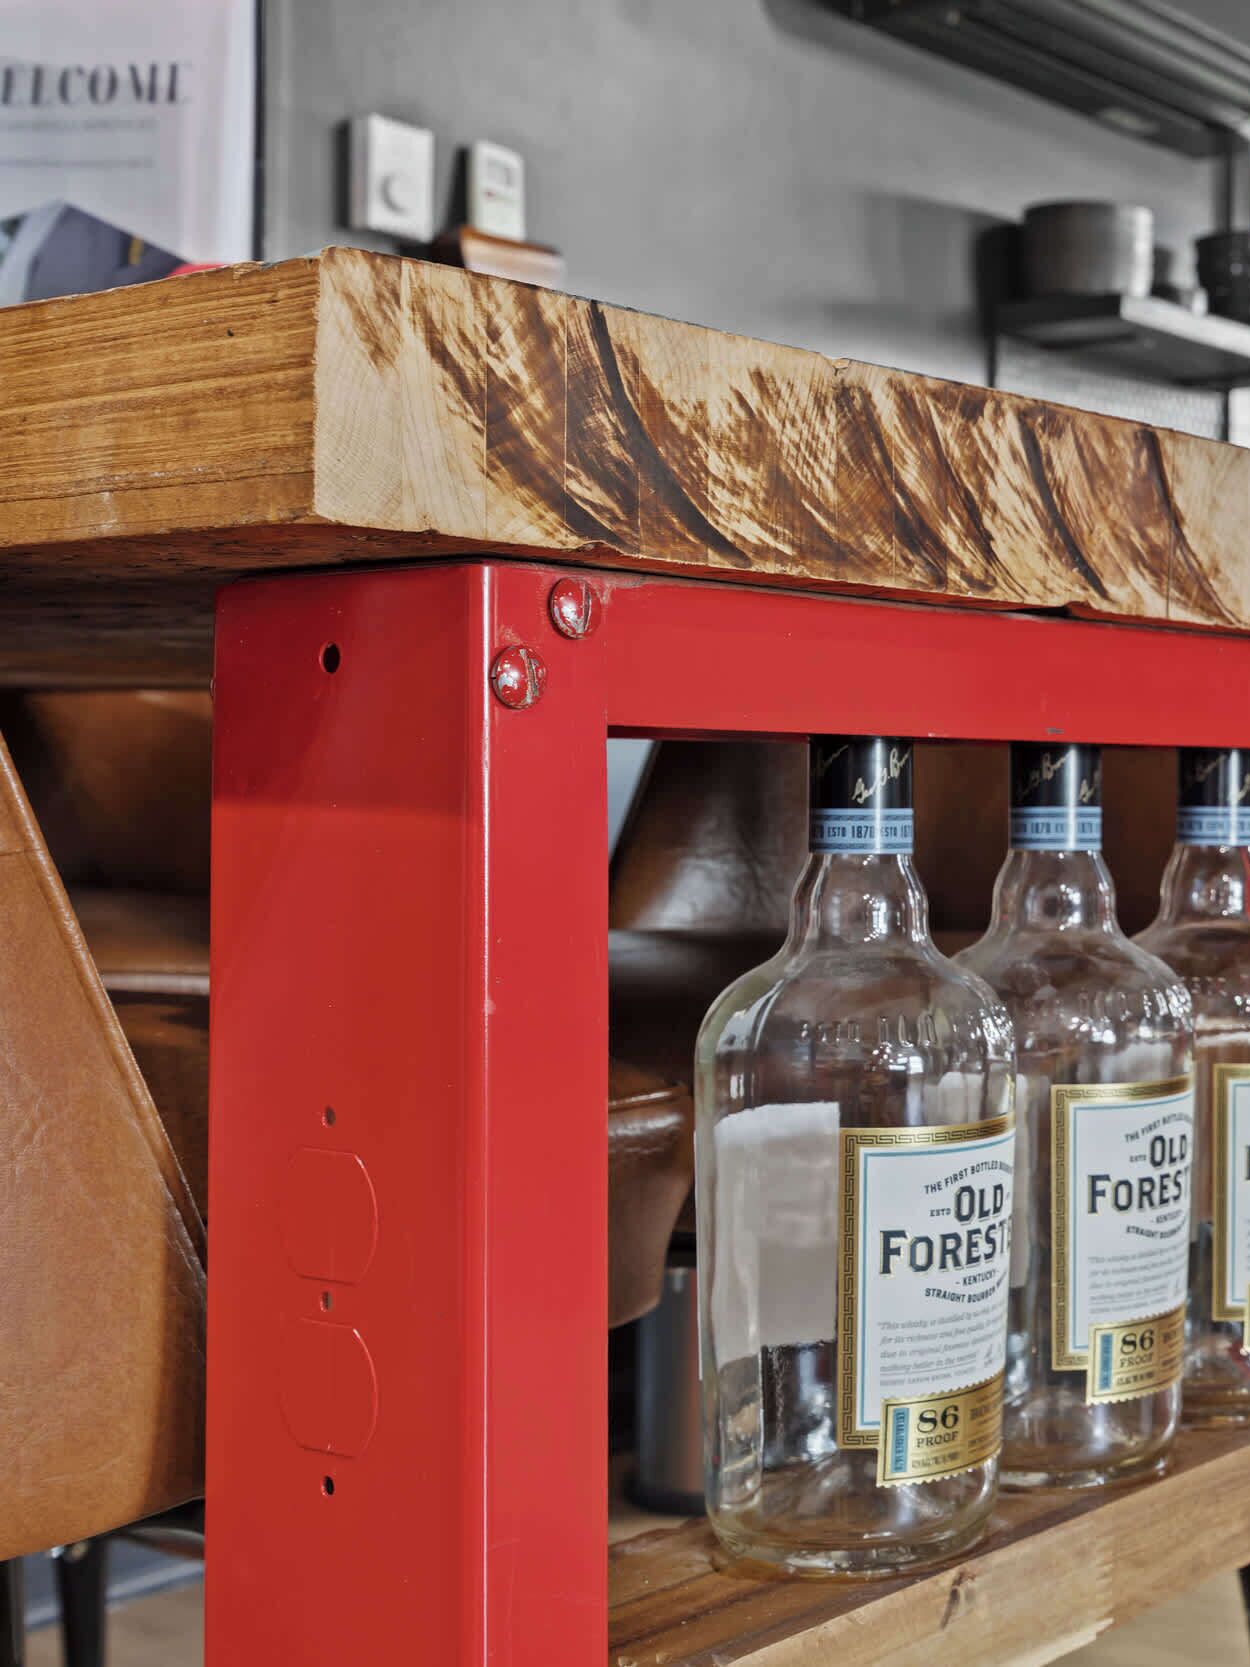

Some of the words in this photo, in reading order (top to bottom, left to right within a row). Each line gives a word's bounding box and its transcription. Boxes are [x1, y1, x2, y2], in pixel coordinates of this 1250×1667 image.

[1150, 1133, 1187, 1168] OLD
[924, 1180, 943, 1195] THE
[944, 1167, 969, 1188] FIRST
[955, 1183, 1004, 1223] OLD
[924, 1287, 967, 1303] STRAIGHT
[1120, 1328, 1155, 1356] 86
[916, 1404, 959, 1434] 86
[916, 1430, 959, 1448] PROOF
